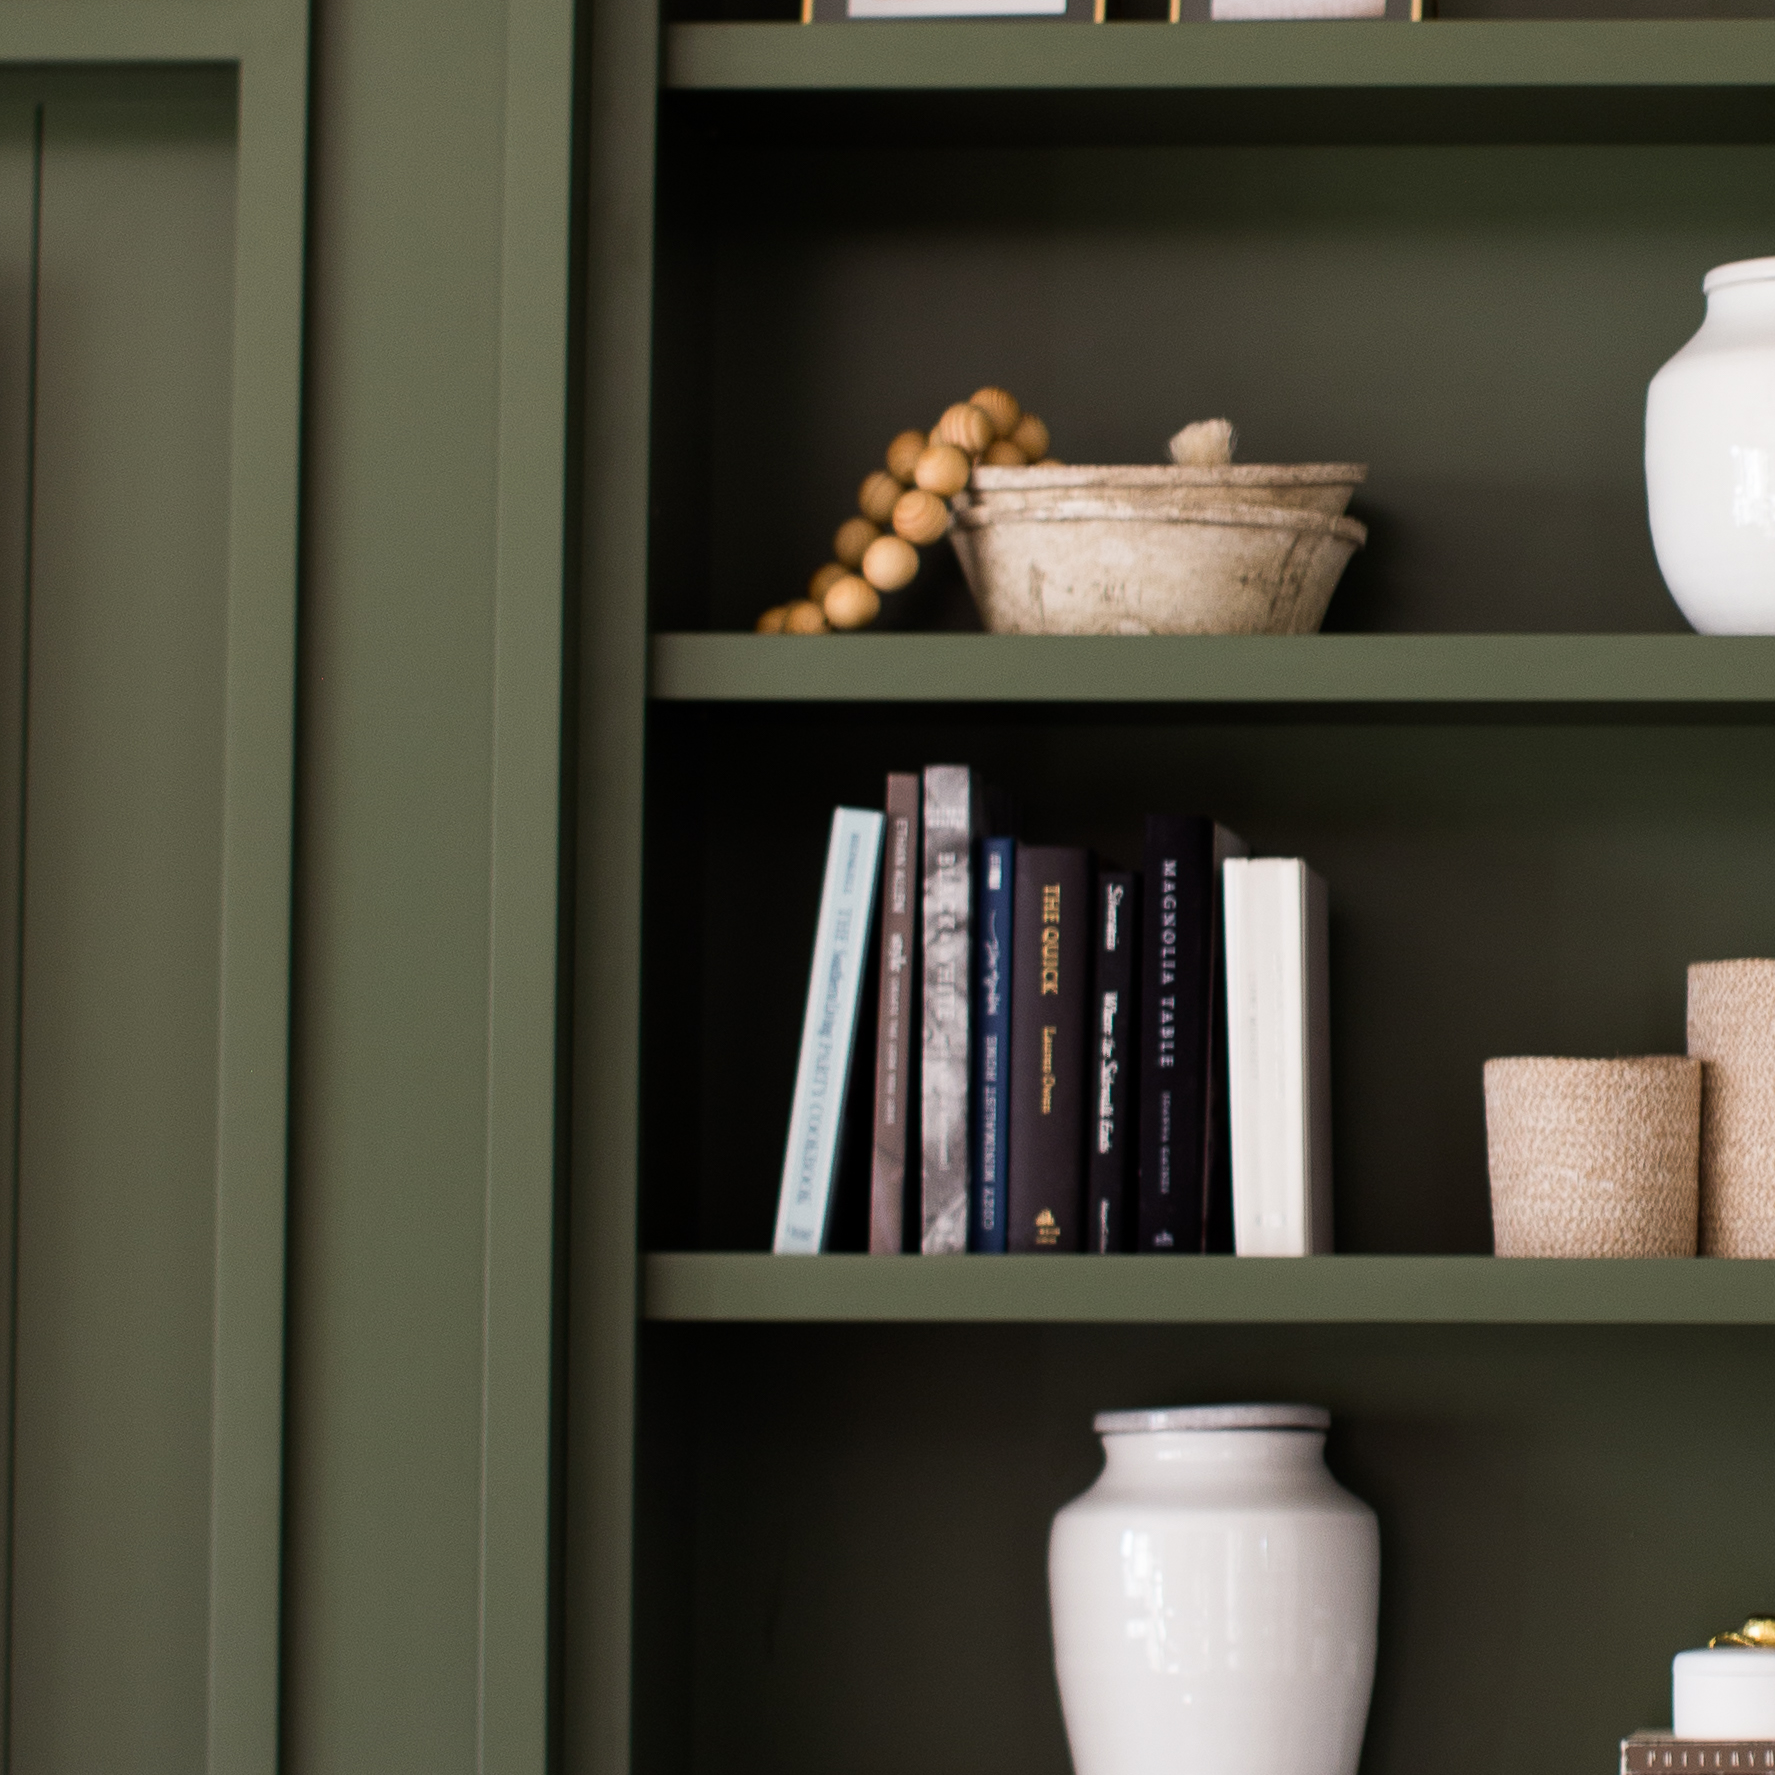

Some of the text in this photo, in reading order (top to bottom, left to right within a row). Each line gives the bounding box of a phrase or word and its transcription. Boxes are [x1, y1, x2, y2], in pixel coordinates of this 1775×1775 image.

[891, 817, 908, 914] ETHAN ALLEN
[938, 851, 956, 930] BLACK
[1041, 884, 1061, 995] THE QUICK
[1158, 859, 1178, 1069] MAGNOLIA TABLE
[983, 1085, 998, 1182] MINIMALIST
